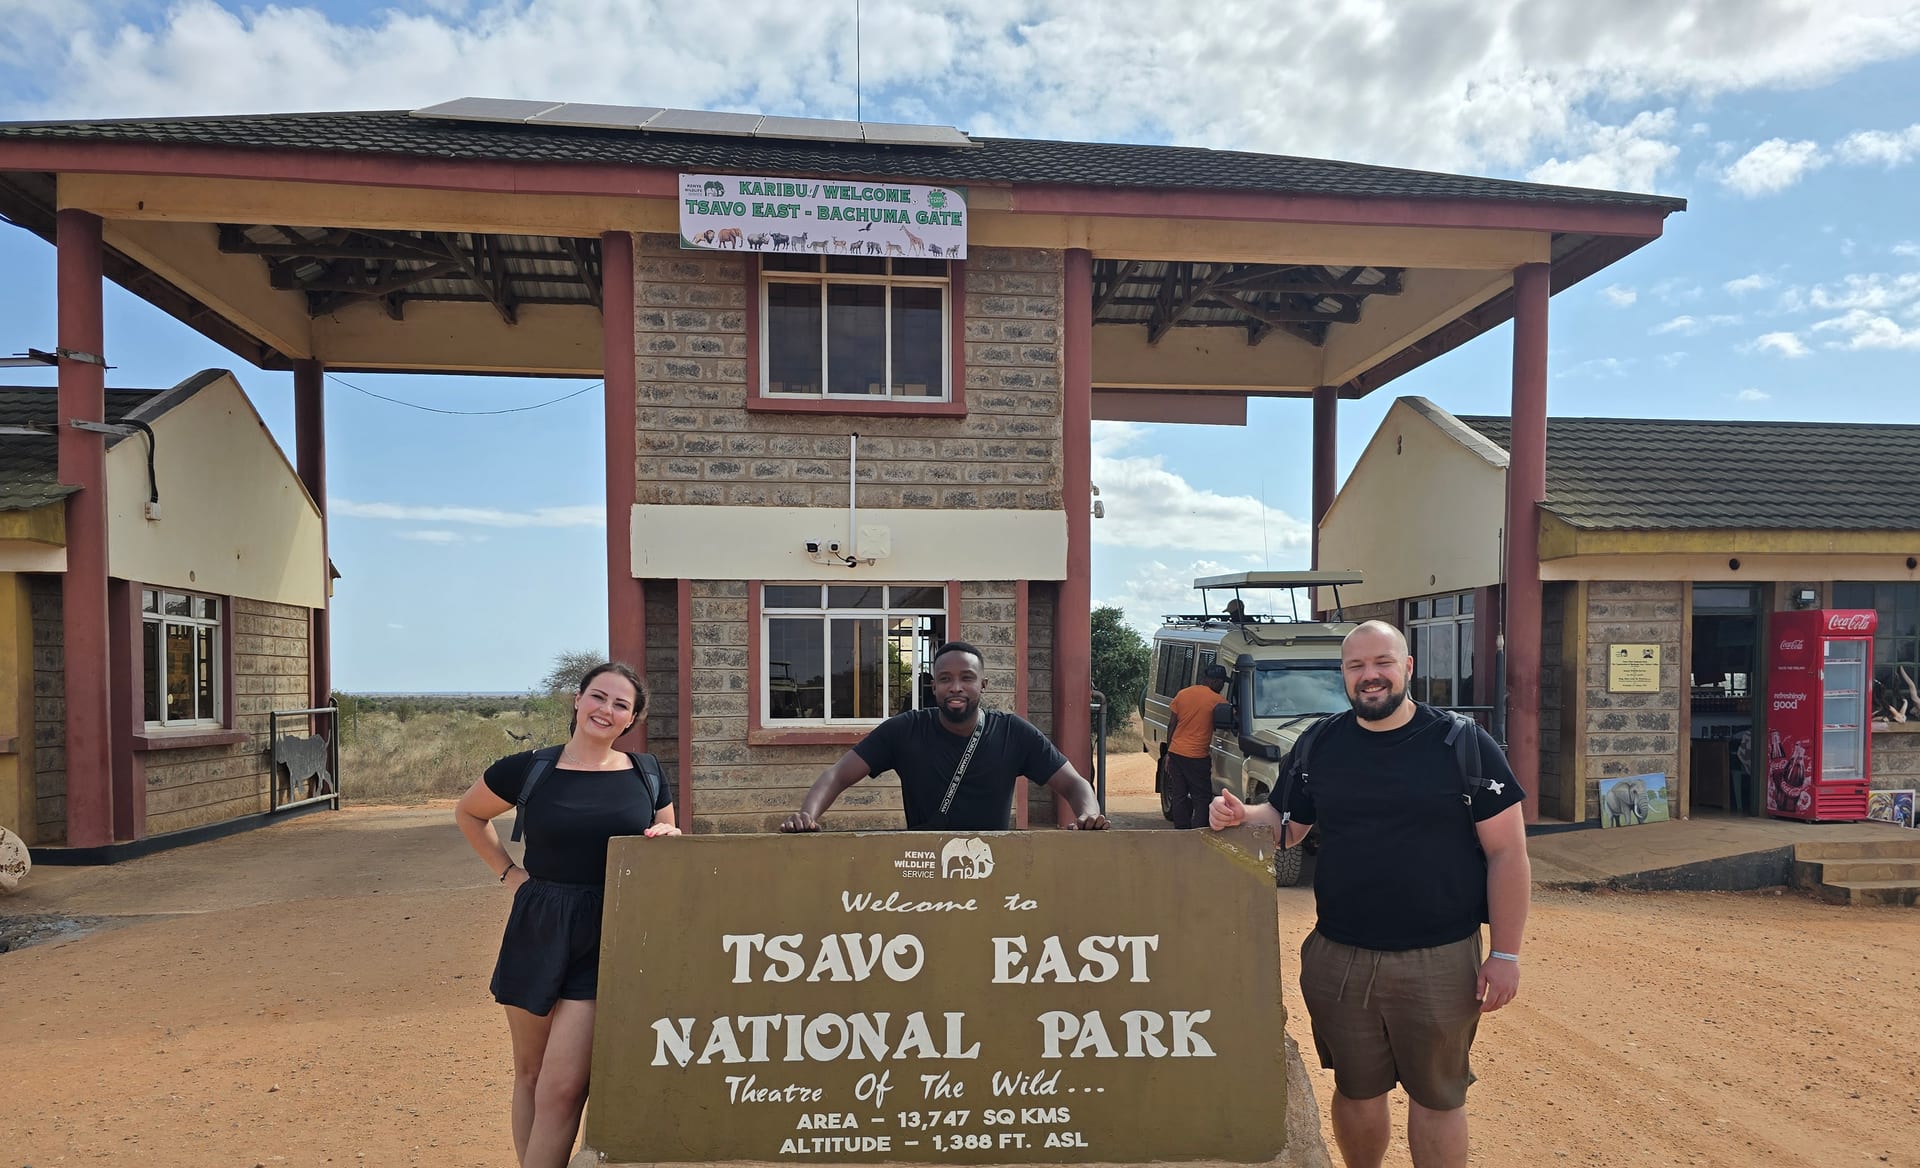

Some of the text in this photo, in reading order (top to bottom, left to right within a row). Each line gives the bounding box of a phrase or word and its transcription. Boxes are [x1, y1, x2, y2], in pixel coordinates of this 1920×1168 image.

[823, 185, 911, 203] WELCOME
[685, 199, 747, 216] TSAVO
[752, 203, 801, 218] EAST
[817, 206, 911, 224] BACHUMA
[916, 210, 963, 226] GATE
[1774, 692, 1807, 701] refreshingly
[1774, 700, 1797, 710] good
[895, 860, 935, 868] WILDLIFE
[905, 851, 935, 859] KENYA
[902, 870, 935, 878] SERVICE
[841, 890, 1038, 912] Welcome to
[723, 933, 1158, 984] TSAVO EAST
[650, 1009, 1216, 1067] NATIONAL PARK
[725, 1075, 823, 1104] Theatre
[855, 1069, 893, 1108] Of
[921, 1070, 964, 1099] The
[796, 1112, 859, 1130] AREA
[898, 1110, 970, 1131] 13,747
[983, 1109, 1016, 1126] SQ
[1021, 1107, 1070, 1124] KMS
[779, 1136, 891, 1154] ALTITUDE
[932, 1134, 993, 1152] 1,388
[999, 1134, 1032, 1149] FT.
[1044, 1132, 1089, 1148] ASL
